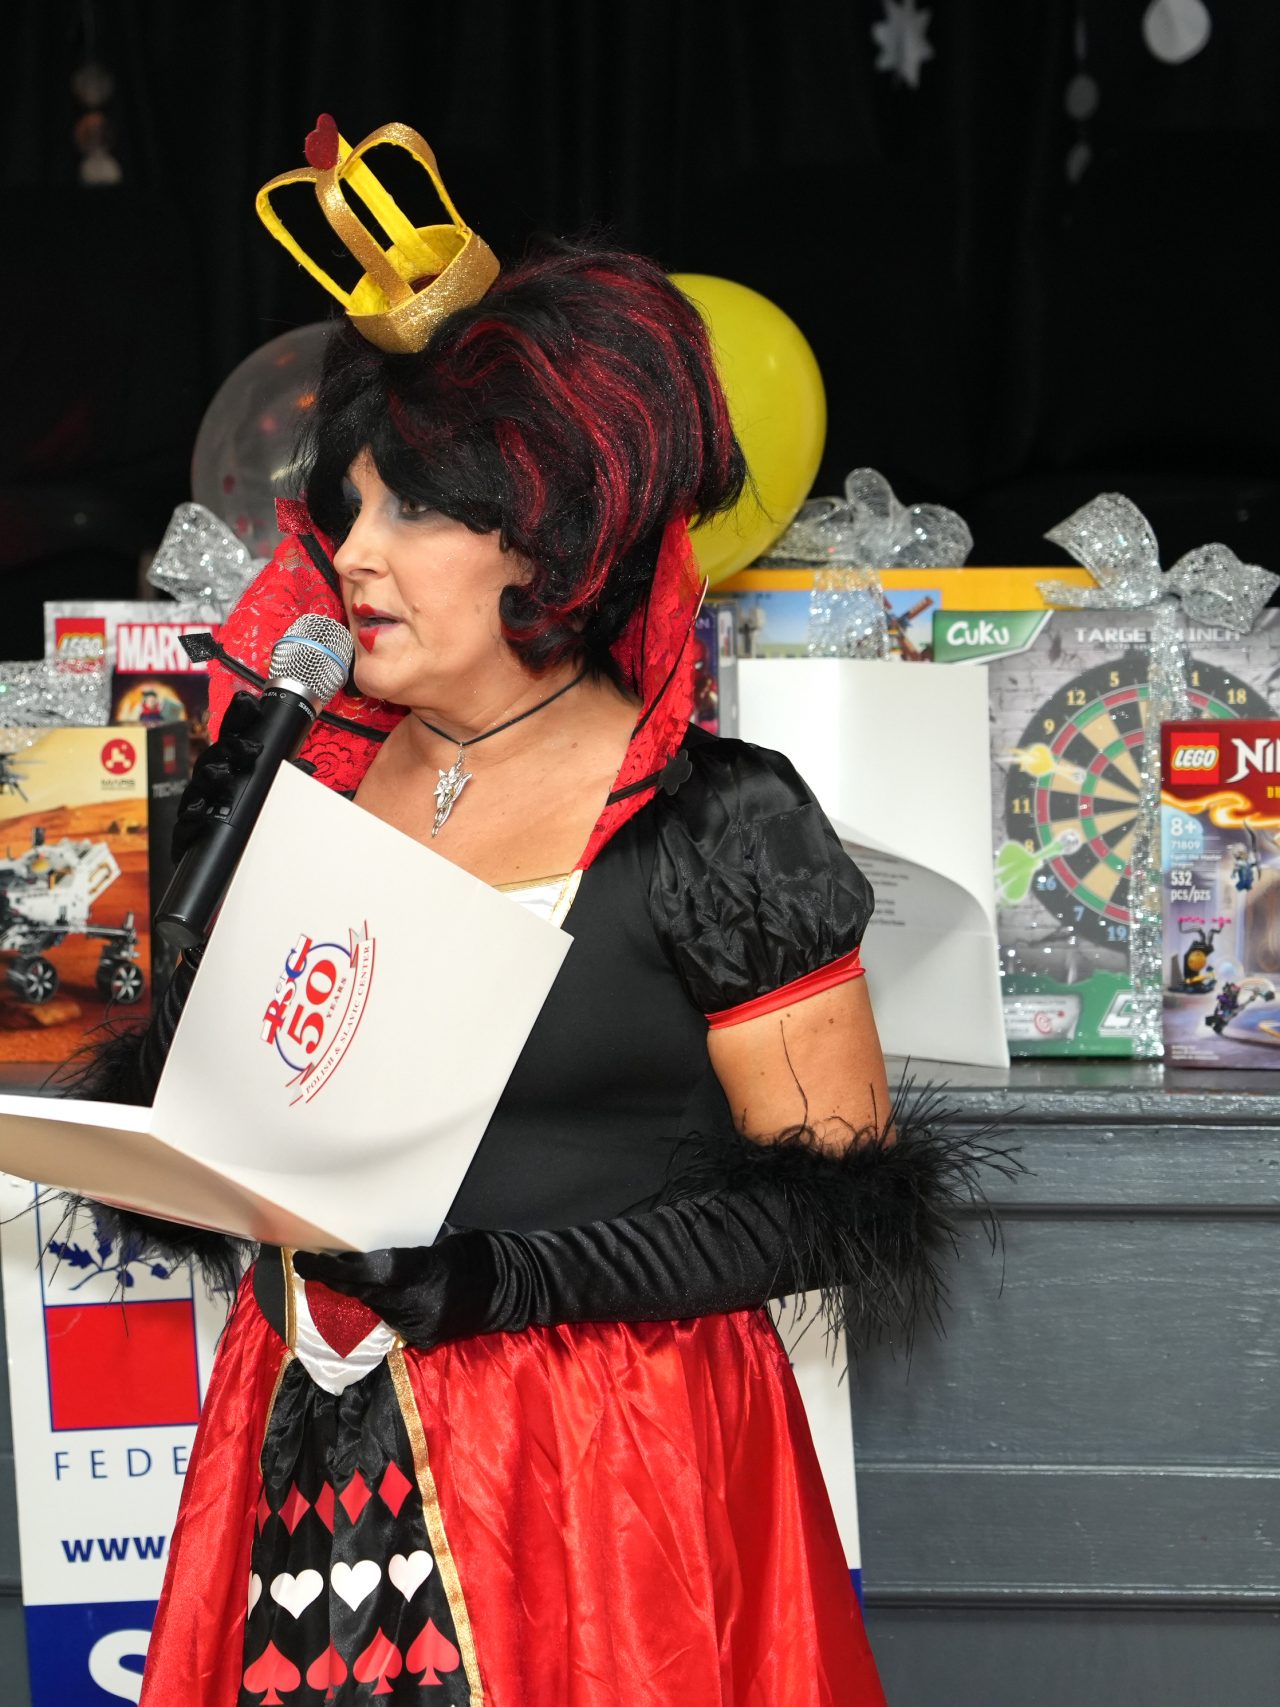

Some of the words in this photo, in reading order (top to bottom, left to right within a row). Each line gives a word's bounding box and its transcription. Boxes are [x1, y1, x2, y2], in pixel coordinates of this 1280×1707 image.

[118, 625, 211, 671] MARV
[1110, 671, 1121, 686] 5
[1192, 672, 1200, 686] 1
[1066, 690, 1086, 705] 12
[1228, 690, 1247, 704] 18
[1043, 719, 1055, 735] 9
[1172, 745, 1219, 770] LEGO
[1013, 799, 1031, 813] 11
[1170, 817, 1196, 837] 8+
[1171, 871, 1192, 885] 532
[1171, 885, 1210, 902] pcs/pzs
[1073, 908, 1084, 922] 7
[1108, 928, 1127, 942] 19
[326, 977, 347, 1019] YEARS
[287, 959, 337, 1055] 50
[305, 1056, 335, 1093] POLISH
[340, 1002, 360, 1043] SLAVIC
[357, 945, 370, 996] CENTER
[55, 1446, 188, 1481] FEDE
[61, 1536, 166, 1563] www
